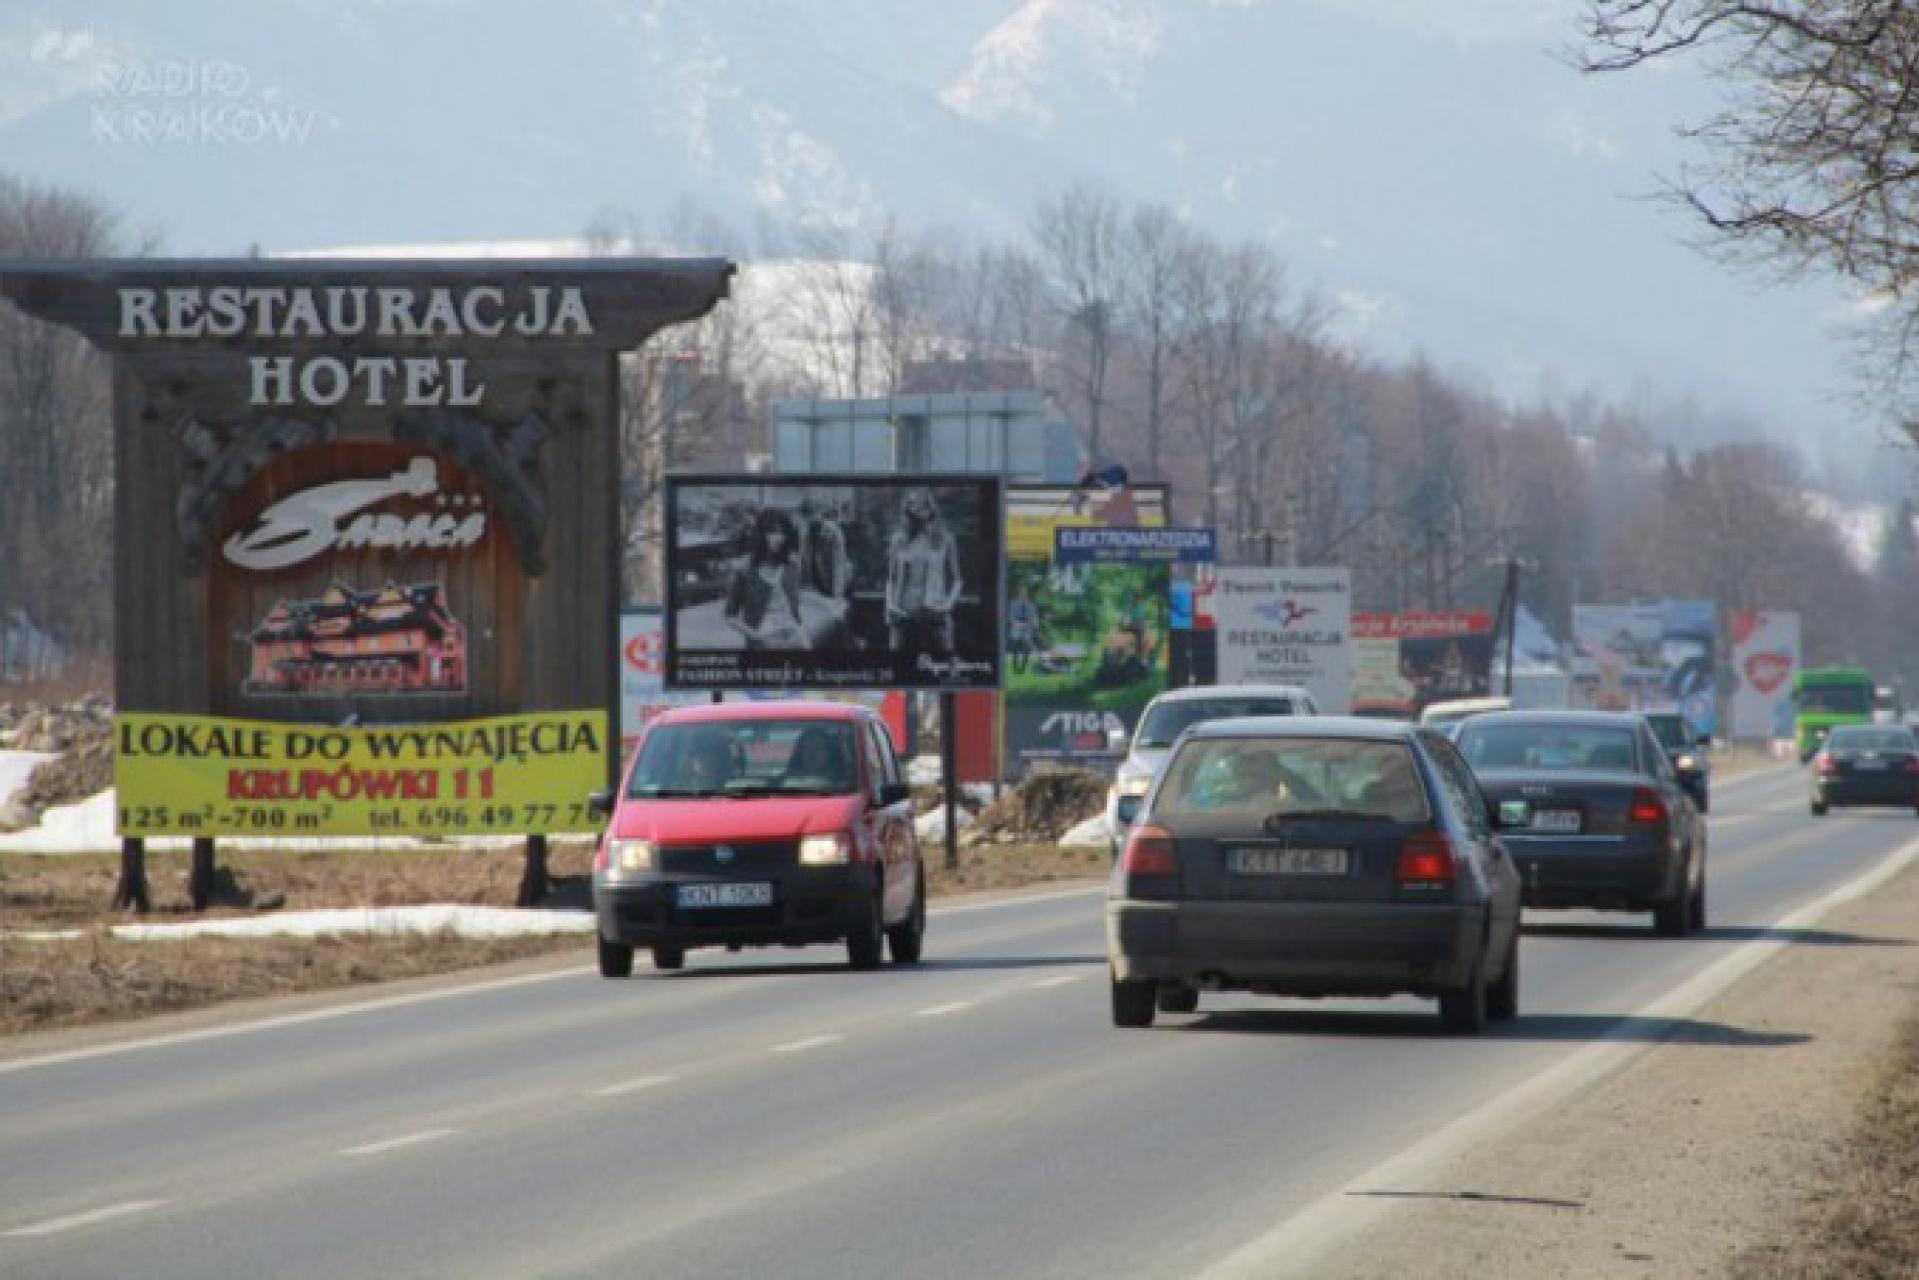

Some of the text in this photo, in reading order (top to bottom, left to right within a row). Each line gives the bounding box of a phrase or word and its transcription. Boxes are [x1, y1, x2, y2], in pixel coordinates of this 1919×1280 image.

[117, 287, 594, 337] RESTAURACJA
[248, 355, 485, 407] HOTEL
[1227, 630, 1343, 646] RESTAURACJA
[1256, 648, 1312, 664] HOTEL
[121, 720, 599, 763] LOKALE DO WYNAJĘCIA
[228, 762, 494, 801] KRUPÓWKI 11
[119, 806, 168, 828] 125
[369, 806, 408, 828] tel.
[417, 805, 469, 828] 696
[482, 804, 515, 826] 49
[524, 802, 557, 826] 77
